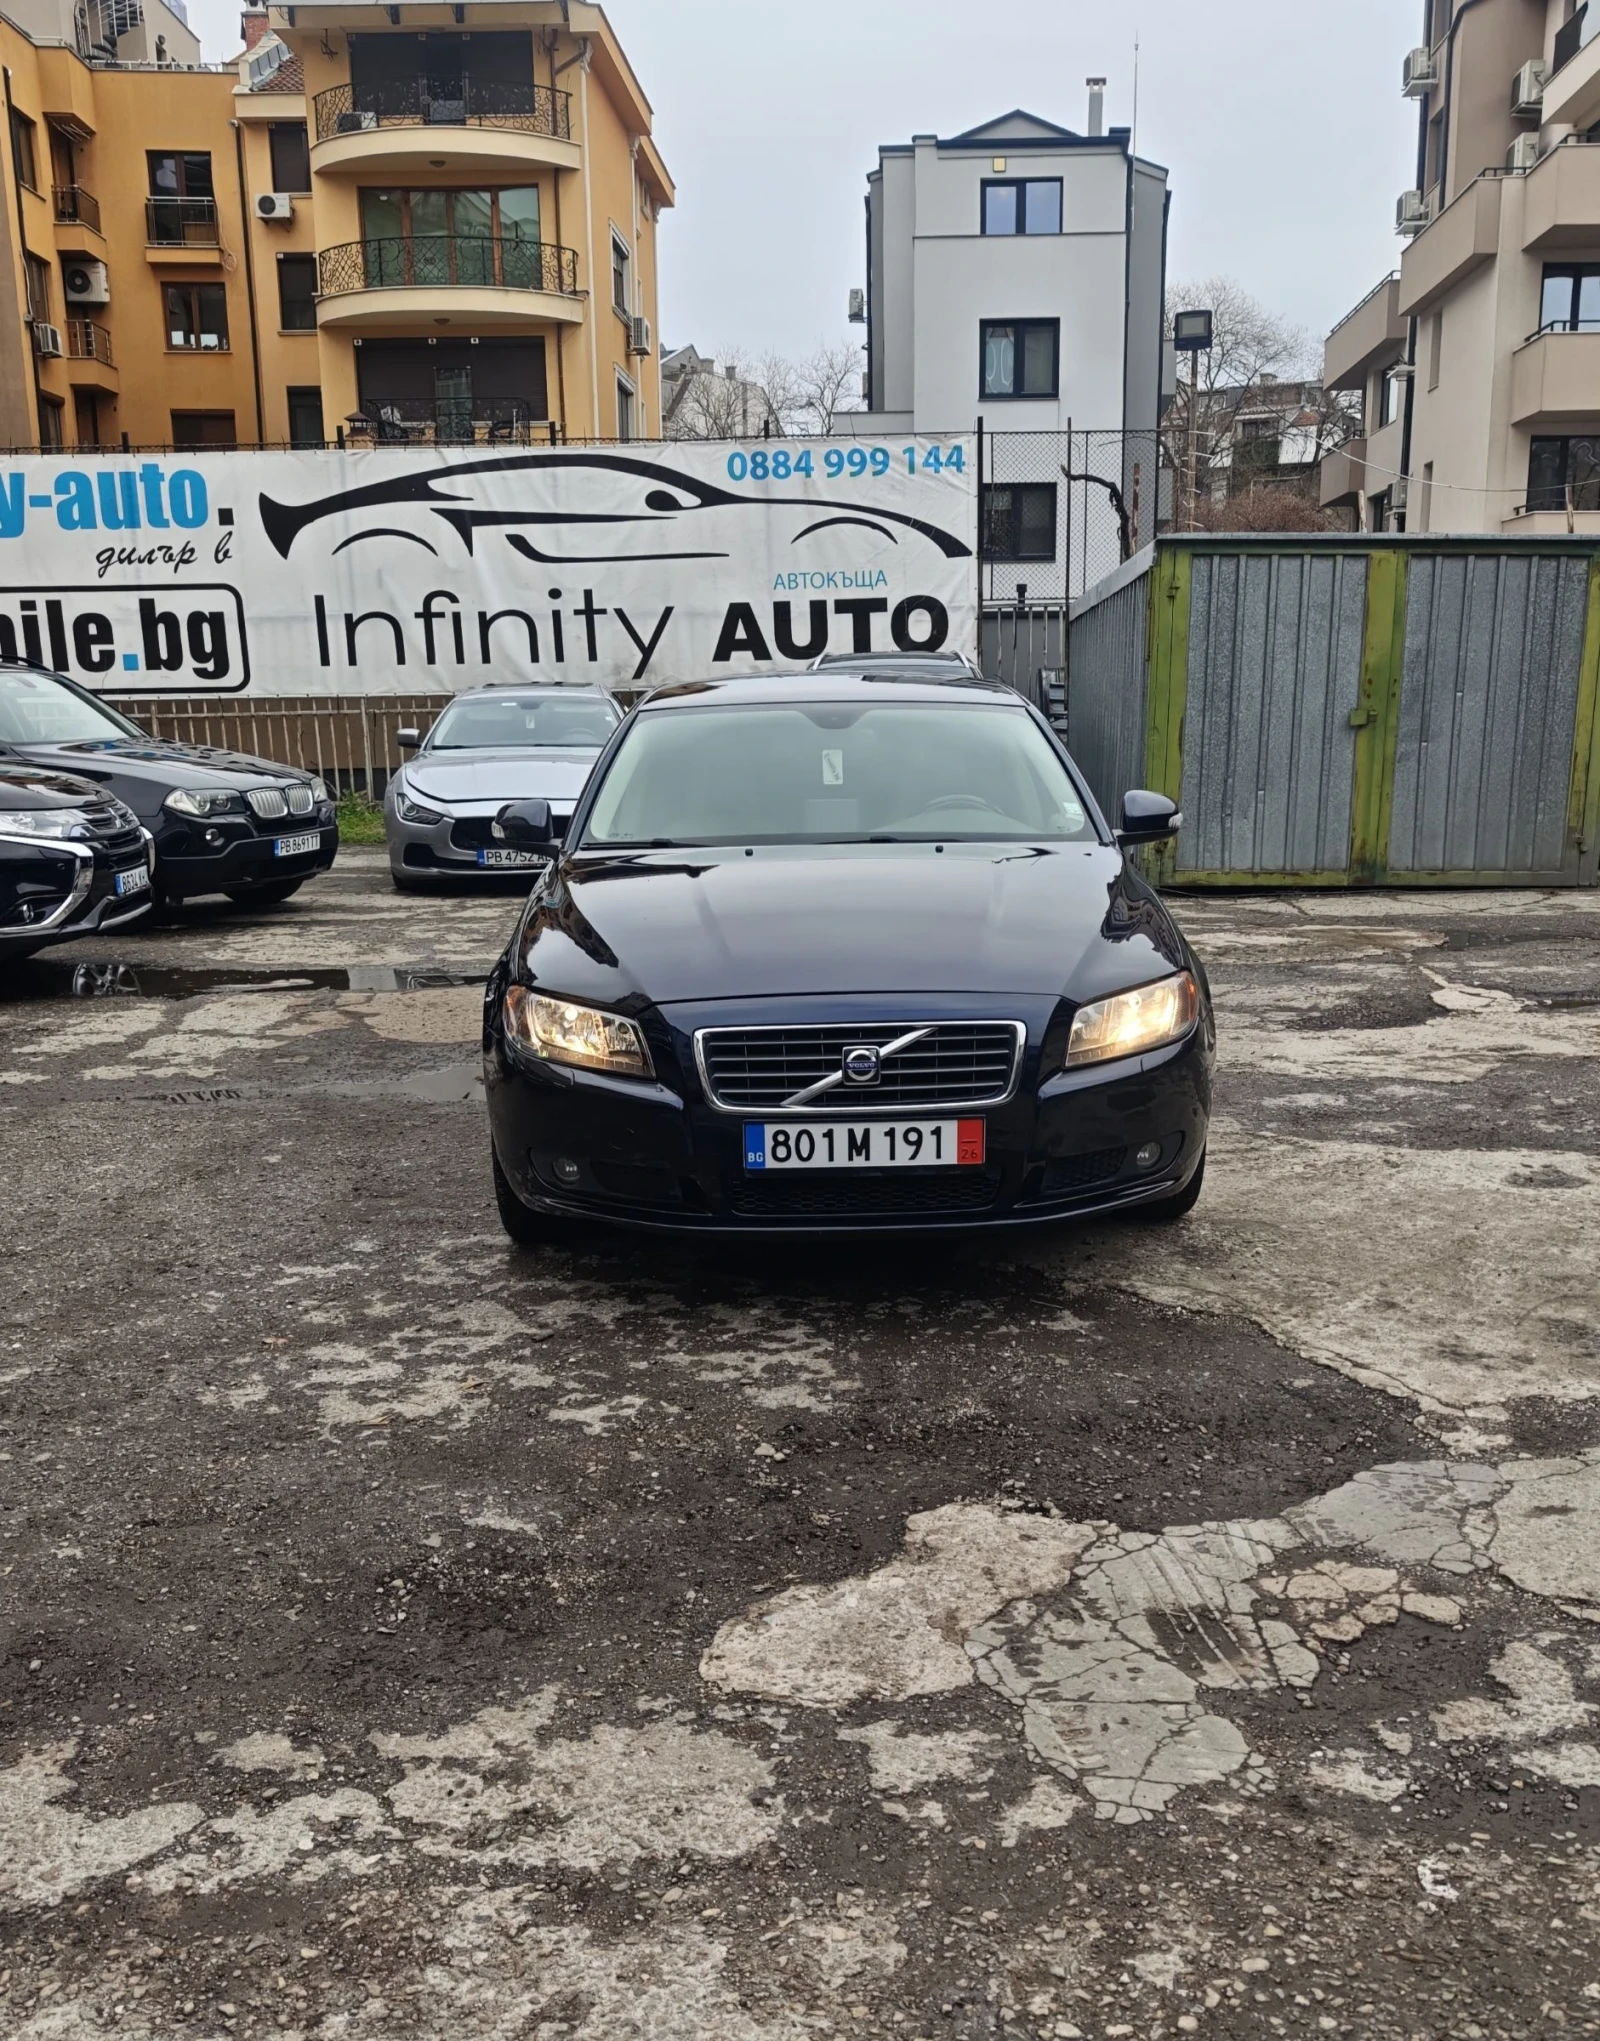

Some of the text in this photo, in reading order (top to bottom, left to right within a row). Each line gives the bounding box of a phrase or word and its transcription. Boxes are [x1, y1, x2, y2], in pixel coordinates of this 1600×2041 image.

[727, 444, 966, 482] 0884 999 144
[773, 569, 888, 592] АВТОКЪЩА
[313, 588, 949, 680] Infinity AUTO
[486, 851, 502, 863] PB
[505, 850, 534, 863] 4752
[771, 1125, 942, 1163] 801 M 191
[960, 1150, 978, 1160] 26
[747, 1152, 764, 1162] BG
